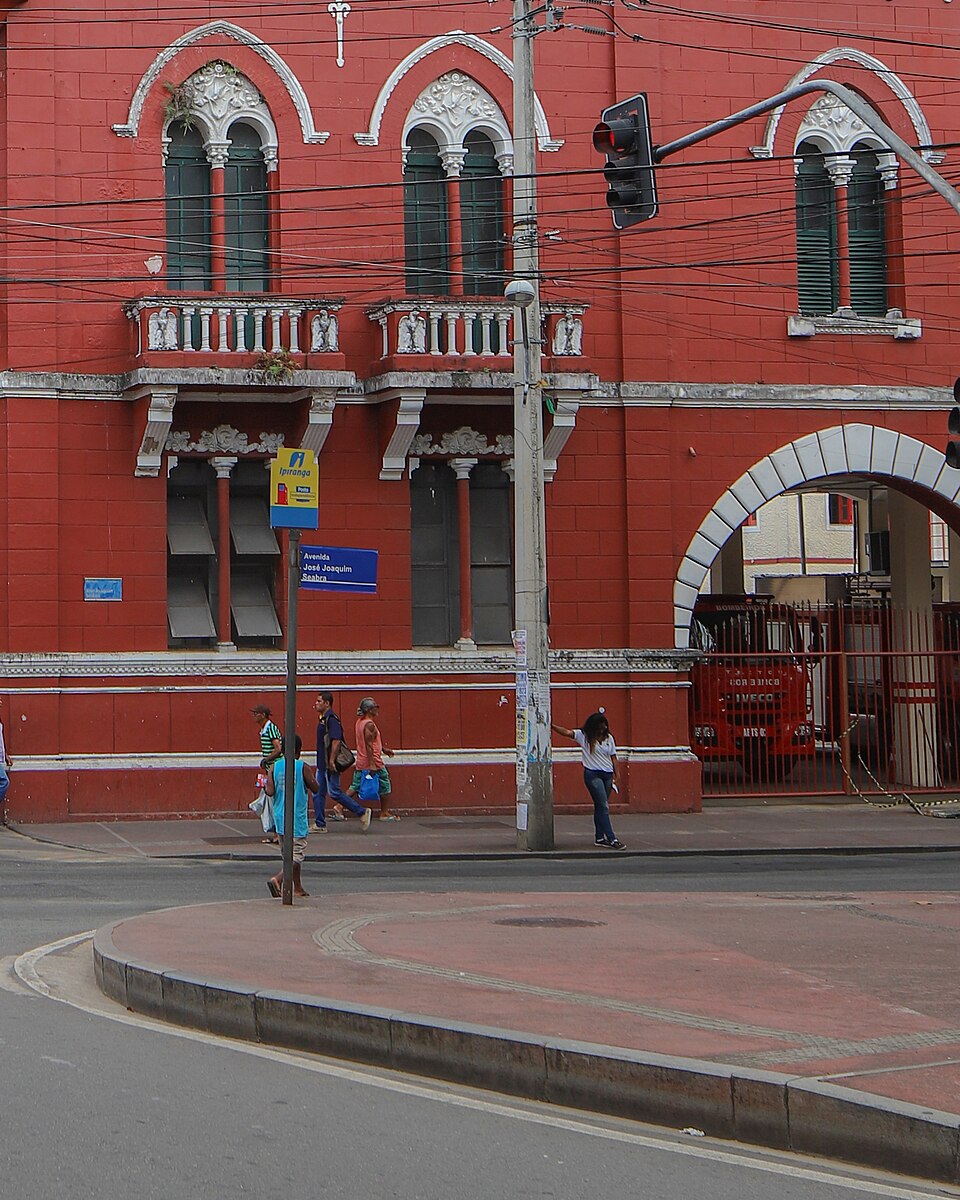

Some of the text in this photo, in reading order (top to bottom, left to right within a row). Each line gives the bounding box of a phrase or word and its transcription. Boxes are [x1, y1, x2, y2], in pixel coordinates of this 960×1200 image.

[280, 467, 310, 477] Ipiranga
[304, 553, 330, 561] Avenida
[322, 565, 352, 573] Joaquim
[302, 573, 327, 581] Seabra
[736, 693, 773, 702] IVECO
